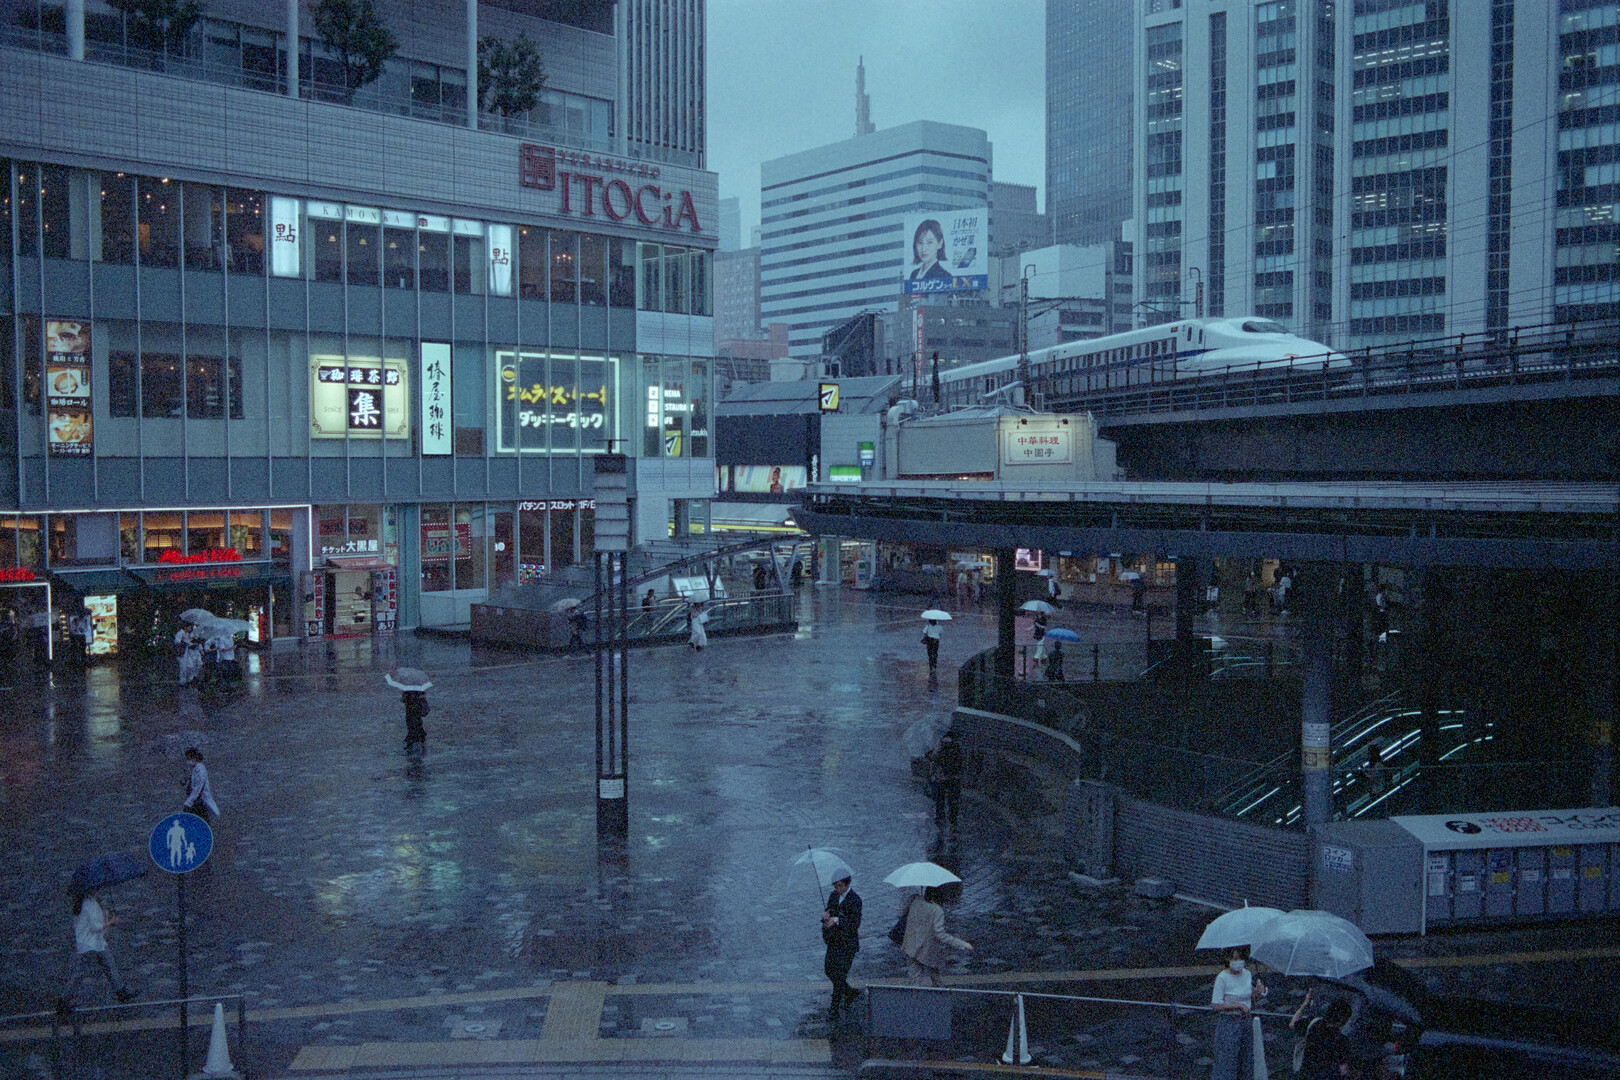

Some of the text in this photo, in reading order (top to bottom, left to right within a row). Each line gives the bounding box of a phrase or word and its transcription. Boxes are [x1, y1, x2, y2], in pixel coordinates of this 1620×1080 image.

[558, 170, 703, 231] ITOCiA
[350, 390, 381, 426] 集
[518, 501, 546, 510] パチンコ
